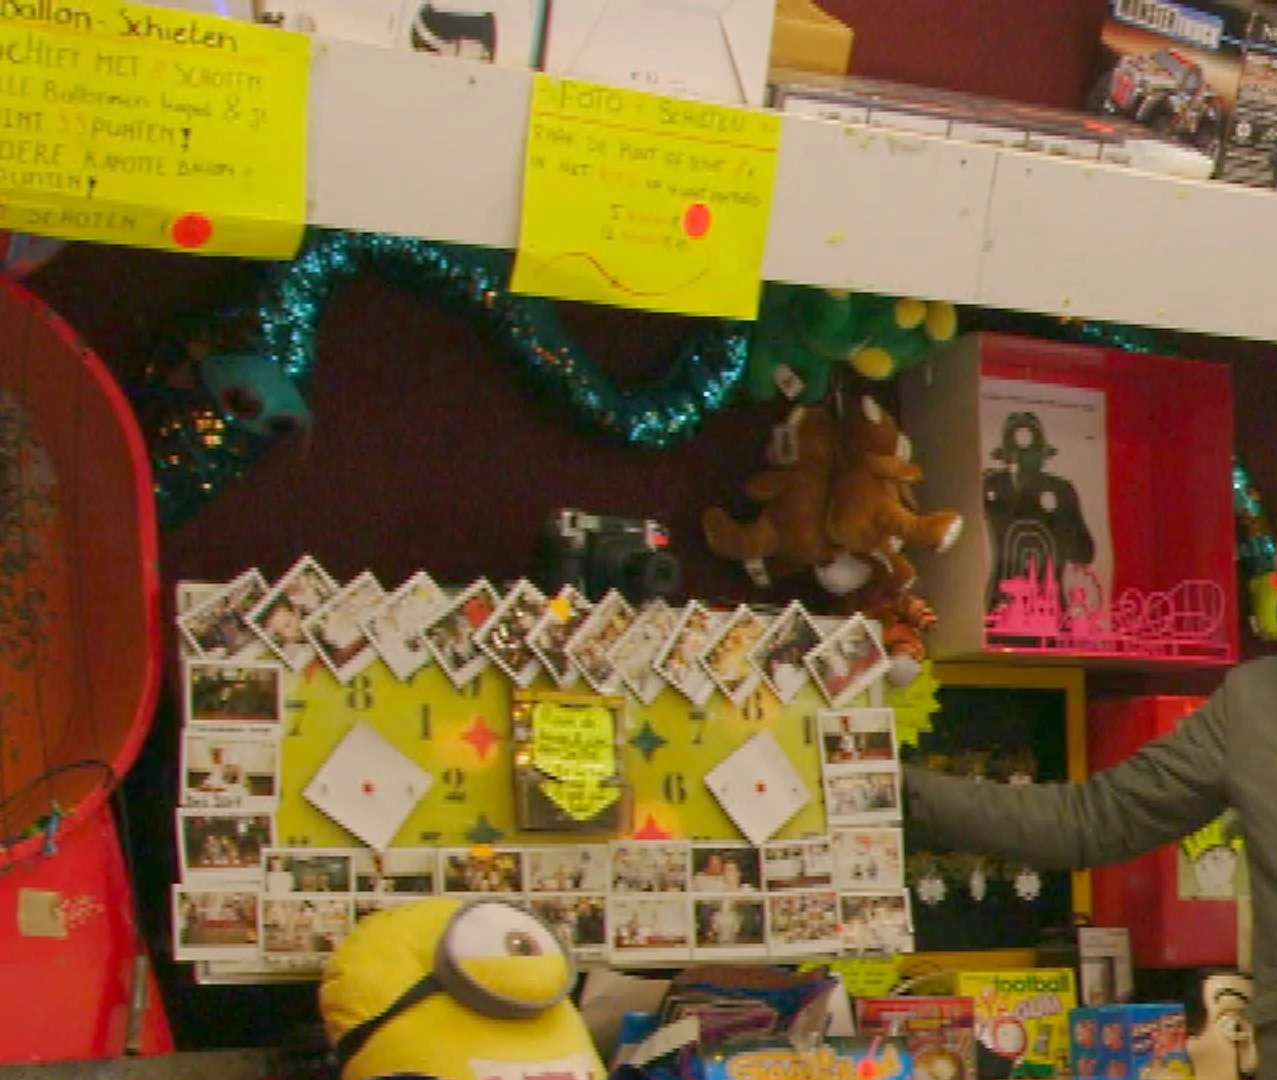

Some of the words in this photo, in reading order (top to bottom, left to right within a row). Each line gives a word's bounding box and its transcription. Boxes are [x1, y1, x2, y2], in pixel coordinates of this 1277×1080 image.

[118, 7, 239, 52] Schieten
[0, 33, 80, 69] CHIET
[95, 53, 140, 77] MET
[560, 80, 624, 113] FOTO
[0, 108, 43, 132] INT
[0, 139, 64, 166] DERE
